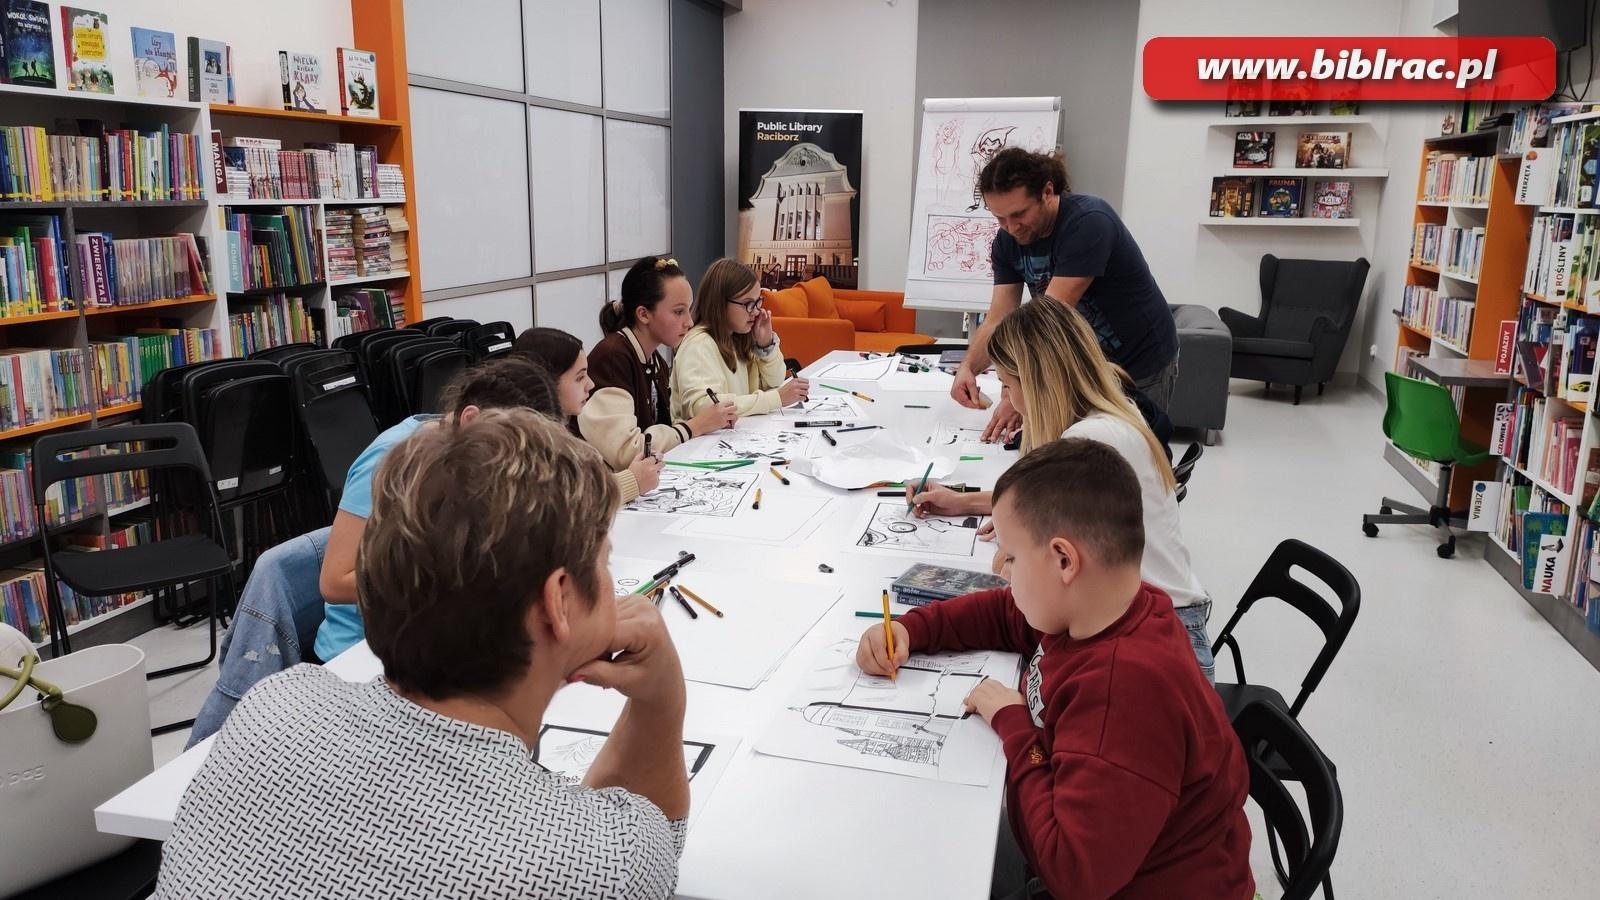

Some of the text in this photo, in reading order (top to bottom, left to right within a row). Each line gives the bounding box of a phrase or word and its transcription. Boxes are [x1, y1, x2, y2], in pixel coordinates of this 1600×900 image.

[757, 121, 823, 134] Public Library
[757, 131, 799, 141] Raciborz
[211, 142, 224, 185] MANGA
[91, 238, 106, 296] ZWIERZĘTA
[1555, 245, 1567, 287] ROŚLINY
[1500, 330, 1511, 364] POJAZDY
[1472, 493, 1483, 520] ZIEMIA
[1541, 556, 1557, 593] NAUKA
